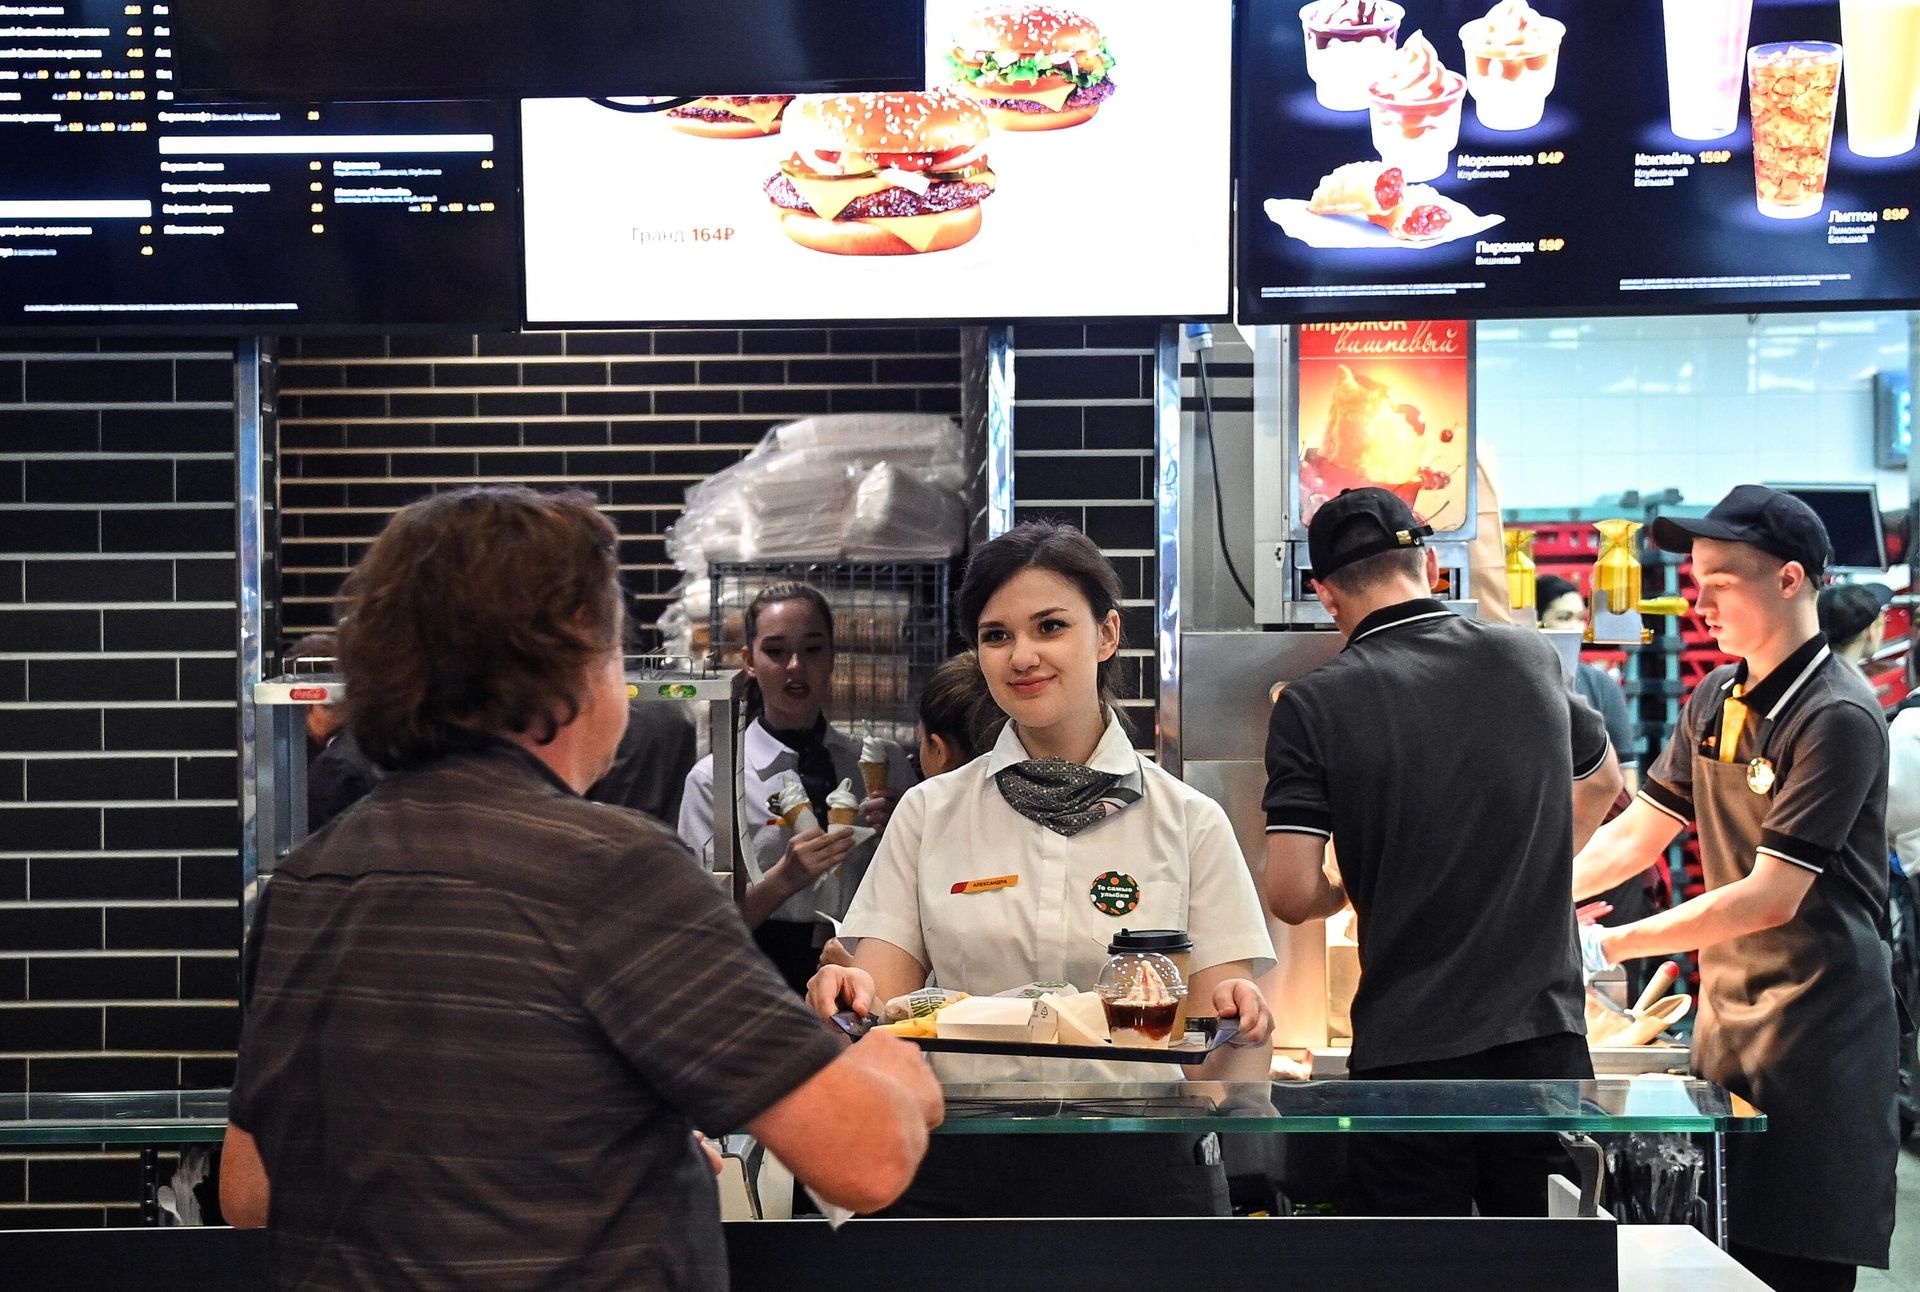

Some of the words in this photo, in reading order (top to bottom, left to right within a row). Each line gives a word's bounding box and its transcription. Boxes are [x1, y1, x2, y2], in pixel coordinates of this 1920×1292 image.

[1457, 154, 1534, 169] Мороженое
[1635, 152, 1695, 166] Коктейль
[1828, 210, 1878, 223] Липтон
[632, 227, 685, 245] Гранд
[1475, 240, 1534, 255] Пирожок
